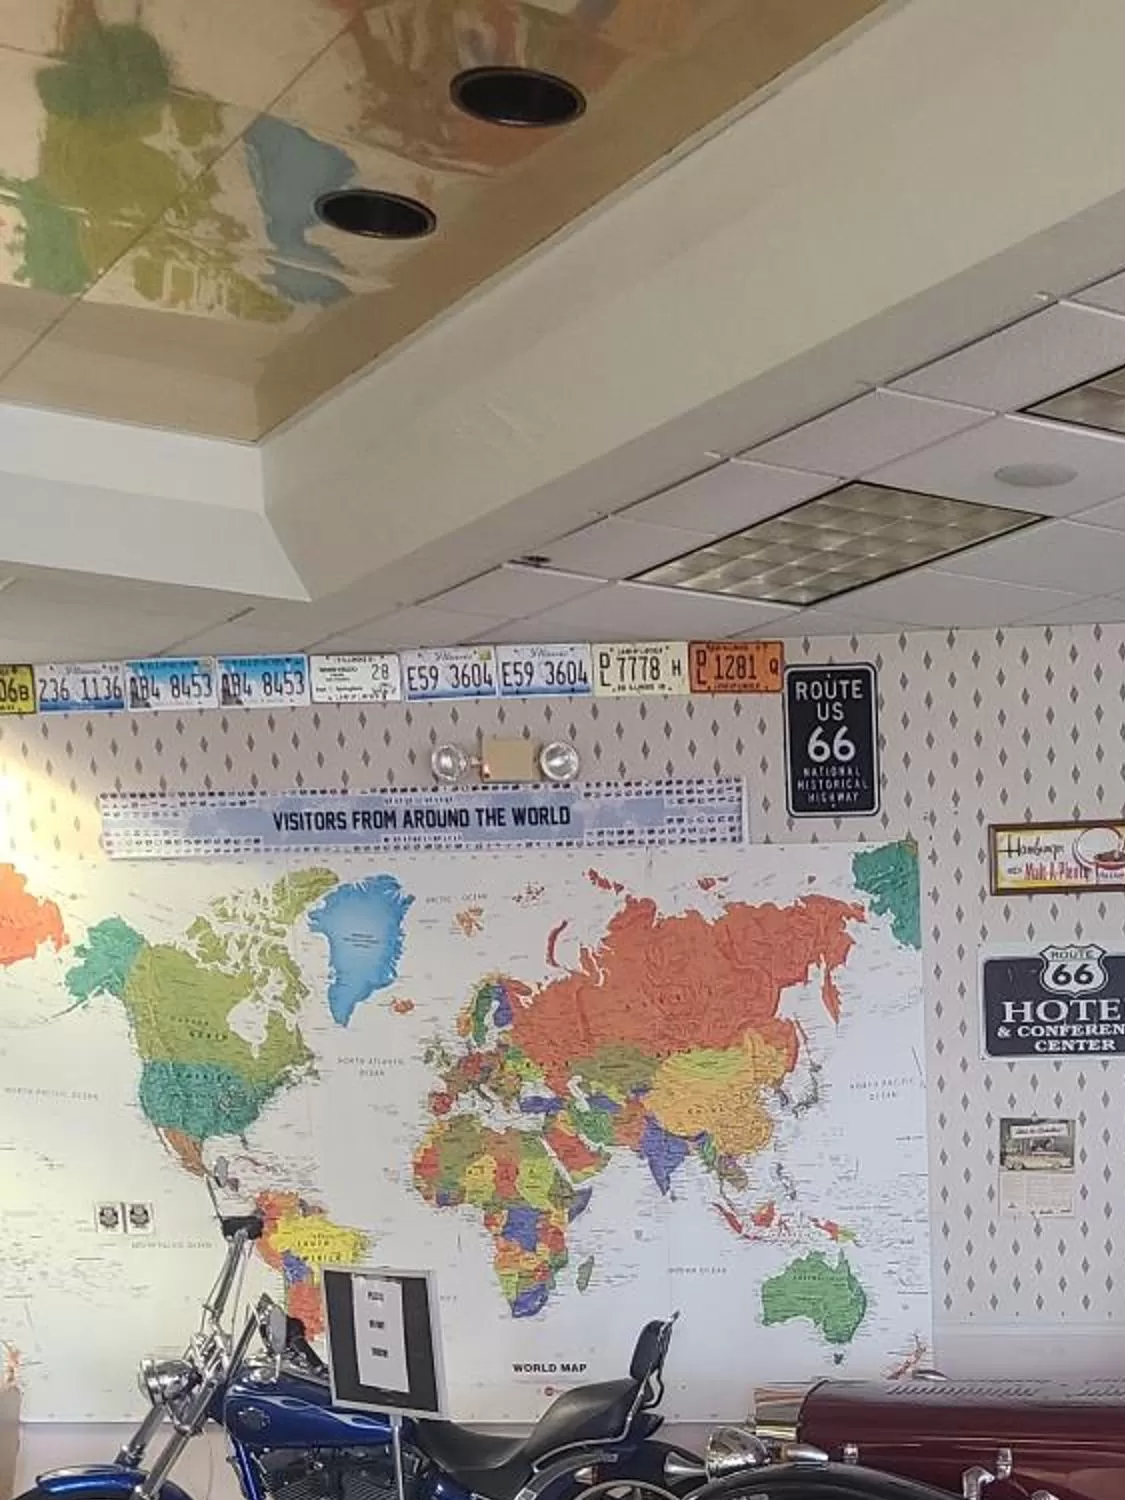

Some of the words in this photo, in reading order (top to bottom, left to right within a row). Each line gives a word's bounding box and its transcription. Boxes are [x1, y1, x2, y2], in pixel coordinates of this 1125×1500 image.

[372, 663, 389, 681] 28
[407, 665, 439, 691] E59
[450, 663, 493, 689] 3604
[502, 661, 534, 687] E59
[545, 660, 588, 686] 3604
[616, 655, 660, 682] 7778
[714, 654, 757, 680] 1281
[40, 677, 70, 702] 236
[82, 676, 122, 700] 1136
[169, 673, 213, 698] 8453
[262, 671, 305, 696] 8453
[795, 679, 864, 701] ROUTE
[816, 701, 844, 721] US
[808, 726, 856, 763] 66
[272, 811, 348, 832] VISITORS
[352, 809, 397, 829] FROM
[403, 808, 470, 828] AROUND
[475, 807, 506, 827] THE
[512, 806, 571, 826] WORLD
[1050, 951, 1099, 961] ROUTE
[1051, 963, 1095, 986] 66
[997, 1026, 1012, 1038] &
[1034, 1039, 1117, 1053] CENTER
[512, 1363, 557, 1373] WORLD
[560, 1362, 587, 1373] MAP
